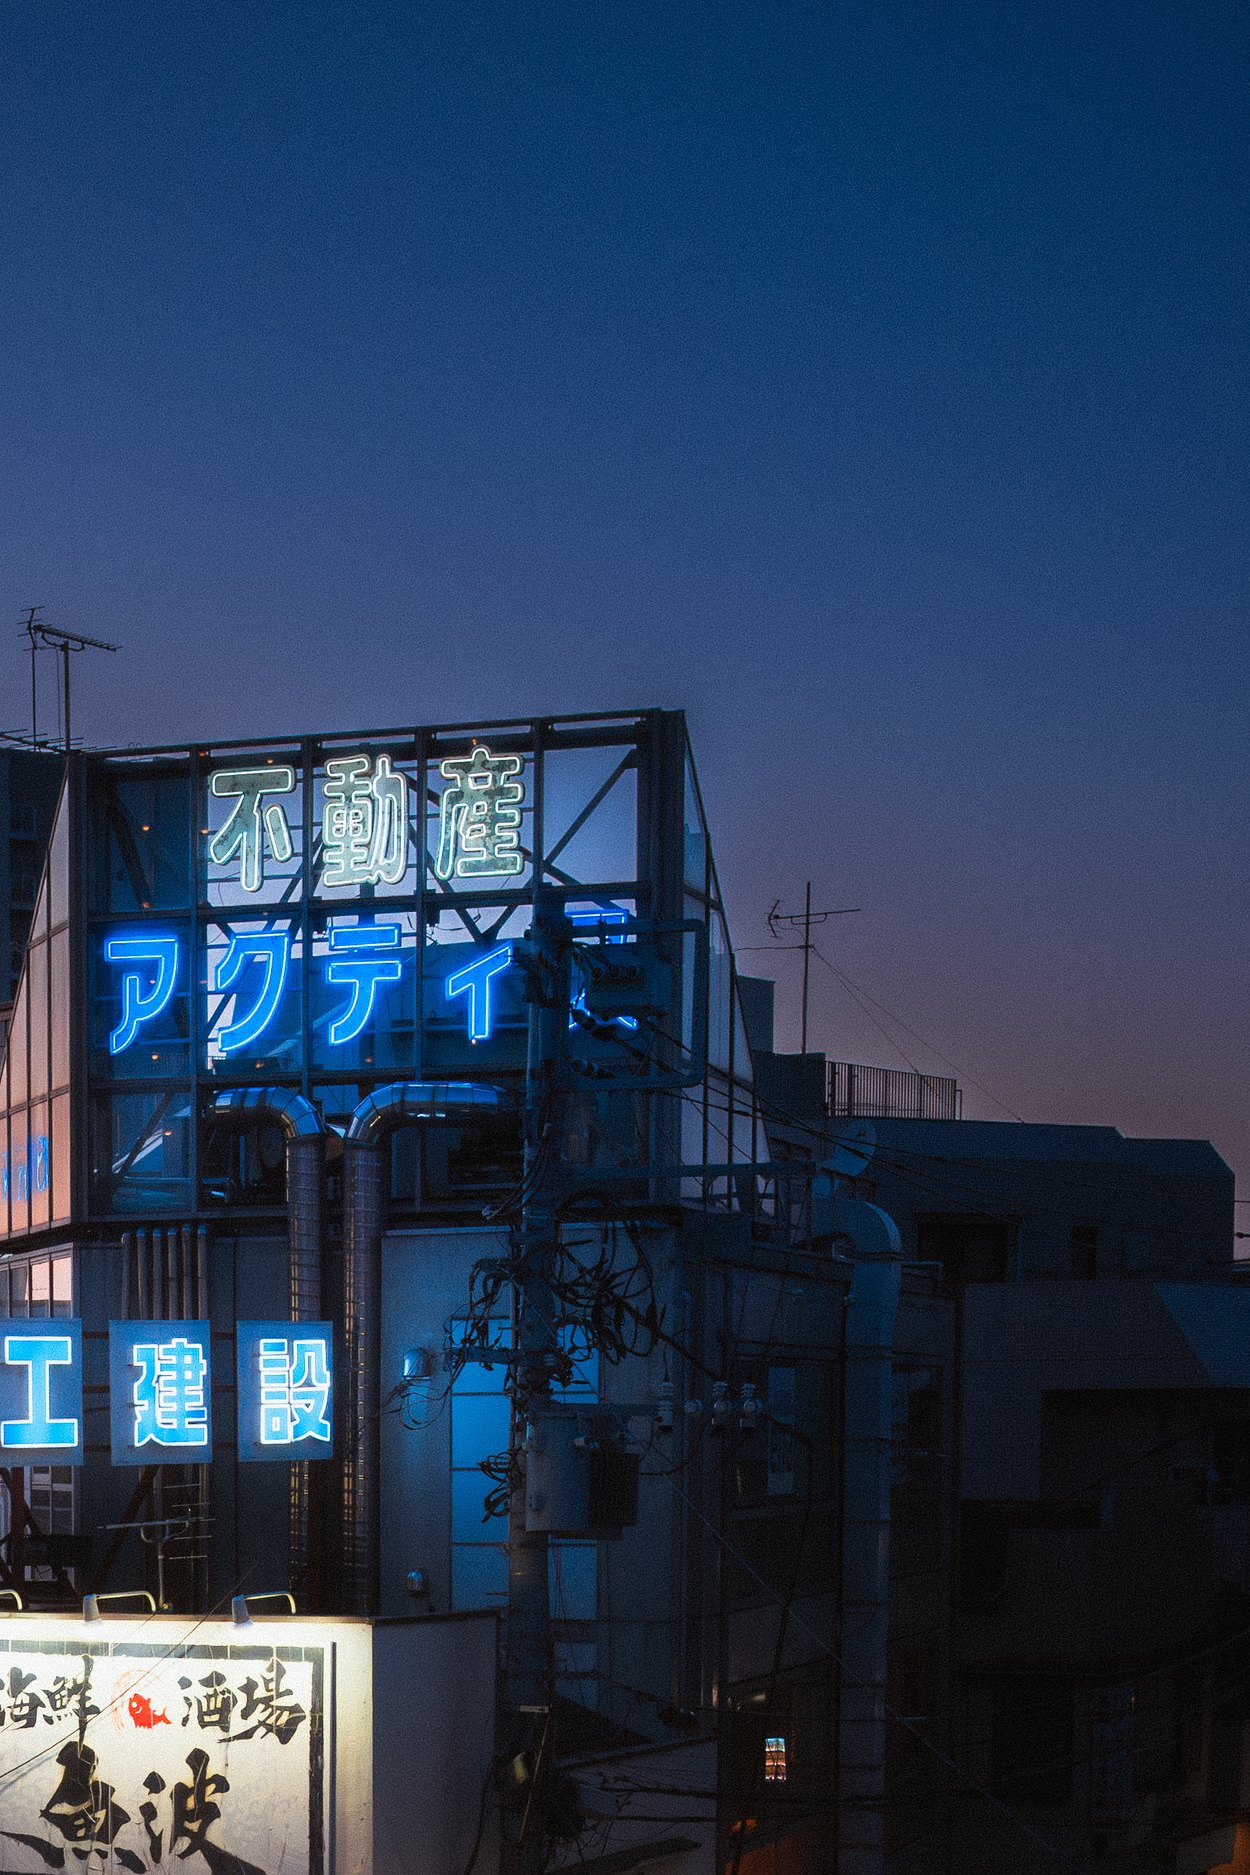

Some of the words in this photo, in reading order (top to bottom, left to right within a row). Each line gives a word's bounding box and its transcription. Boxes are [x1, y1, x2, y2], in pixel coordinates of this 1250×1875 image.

[209, 745, 525, 892] 不動産
[177, 1657, 307, 1745] 酒場
